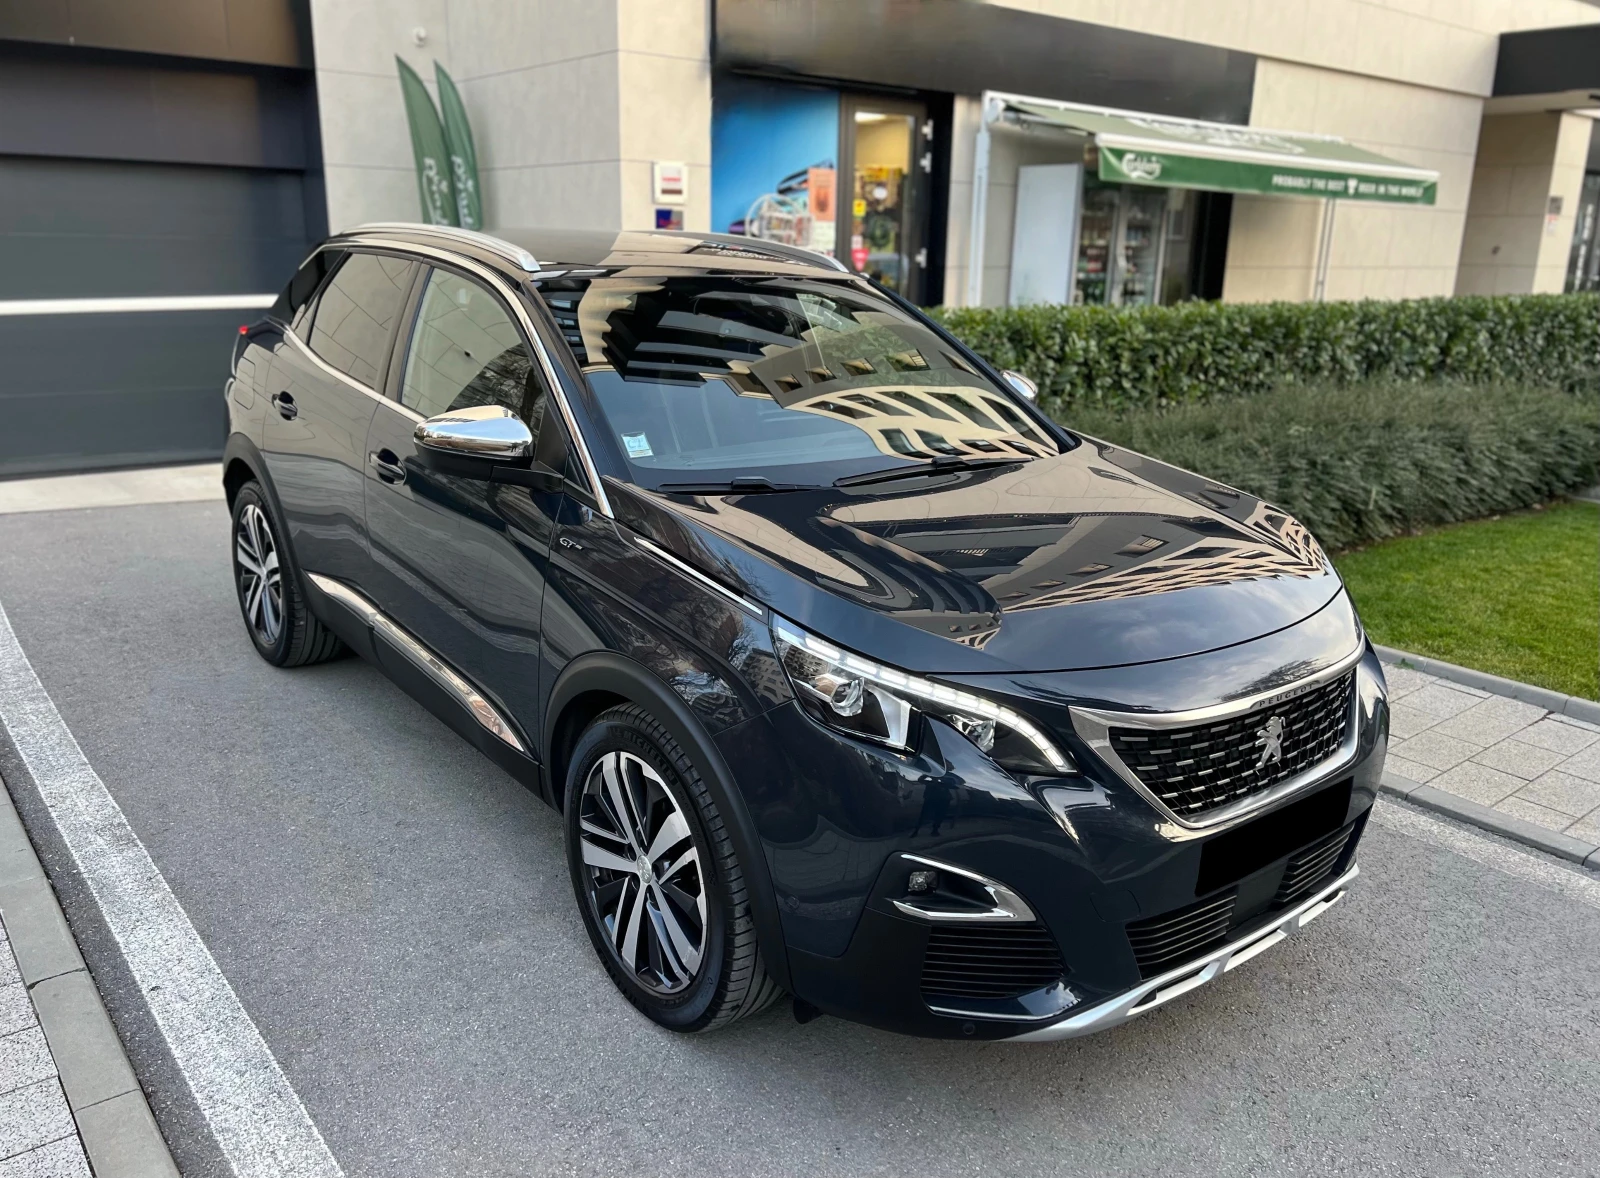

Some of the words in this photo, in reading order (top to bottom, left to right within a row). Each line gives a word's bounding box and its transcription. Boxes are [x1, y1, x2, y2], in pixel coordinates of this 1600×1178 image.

[560, 537, 577, 548] GT
[1260, 683, 1312, 707] PEUGEOT
[623, 731, 675, 782] MICHELIN
